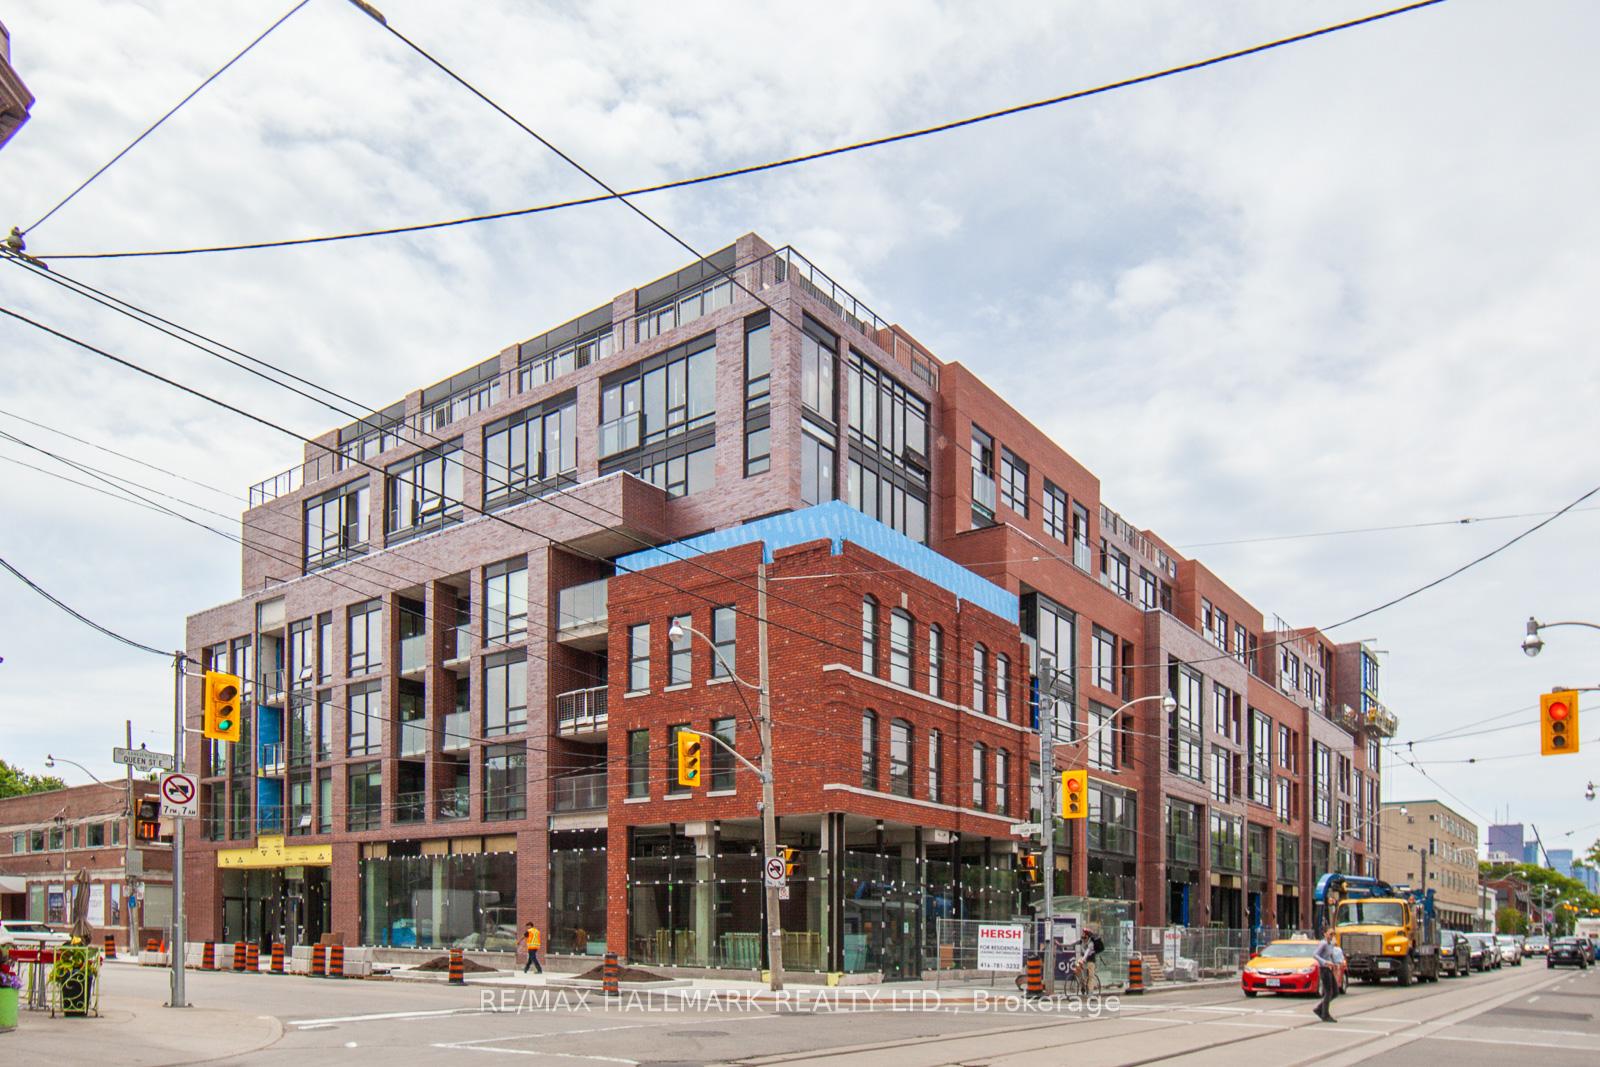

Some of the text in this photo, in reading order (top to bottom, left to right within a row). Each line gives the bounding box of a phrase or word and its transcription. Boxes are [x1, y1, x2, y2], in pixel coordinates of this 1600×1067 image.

[124, 755, 146, 765] QUEEN
[149, 758, 156, 766] ST
[164, 805, 169, 814] 7
[182, 806, 188, 815] 7
[981, 929, 1021, 939] HERSH
